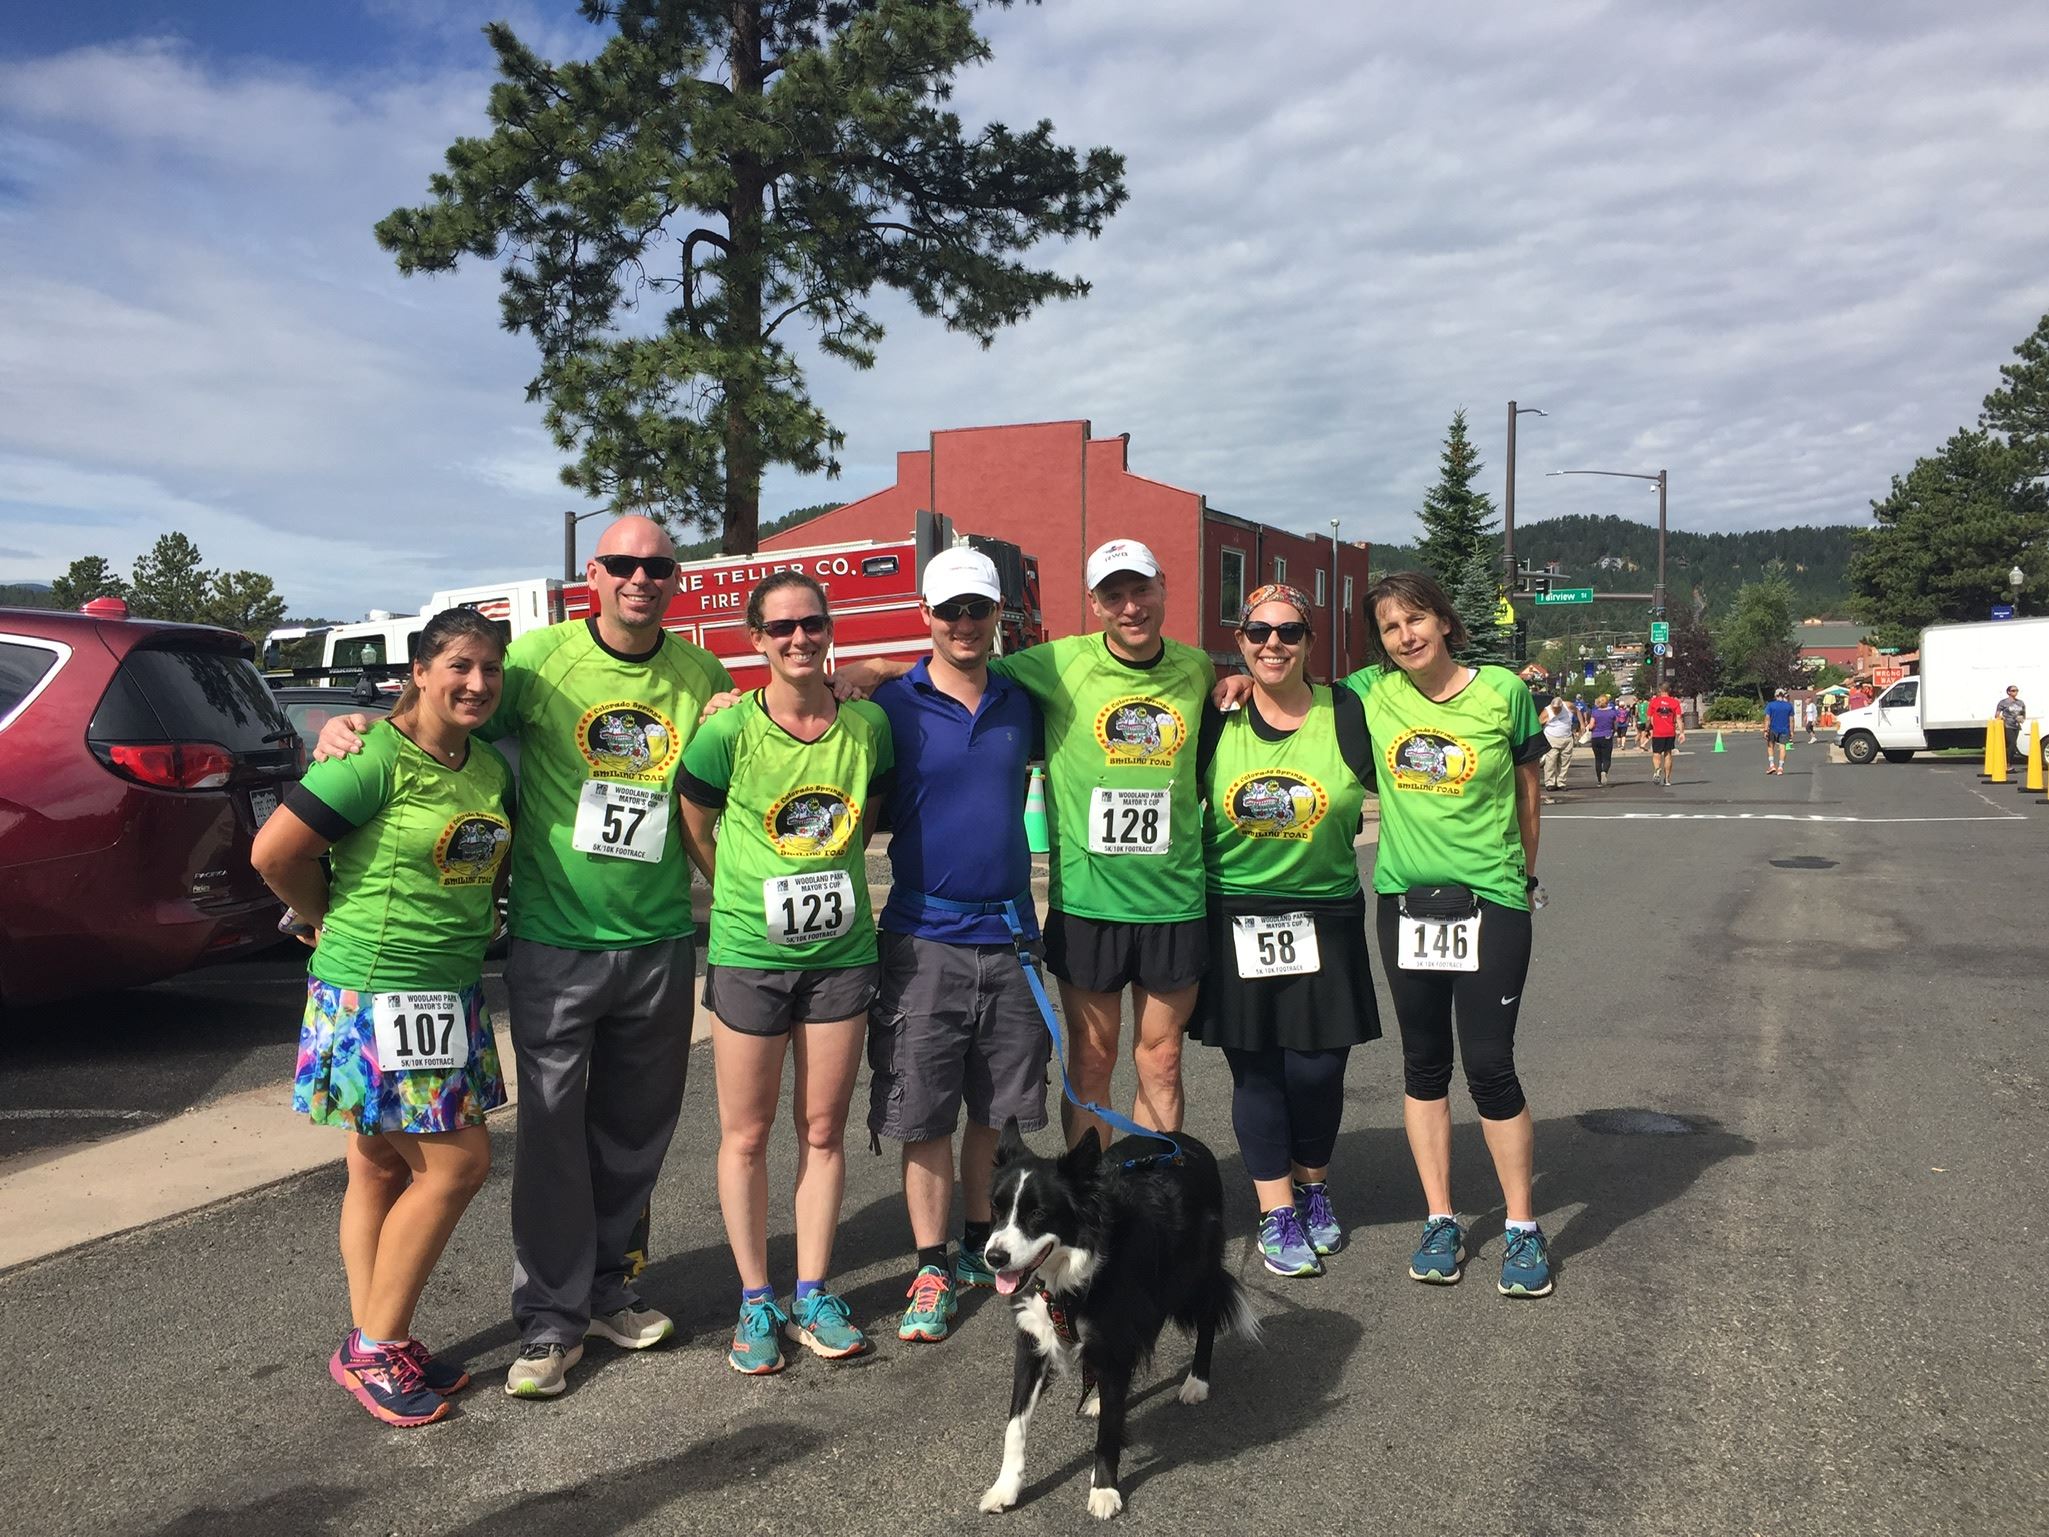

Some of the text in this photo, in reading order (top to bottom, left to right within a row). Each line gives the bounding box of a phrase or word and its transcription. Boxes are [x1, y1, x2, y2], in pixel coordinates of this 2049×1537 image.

[714, 564, 804, 586] TELLER
[815, 557, 857, 576] CO.
[701, 592, 740, 610] FIRE
[594, 701, 662, 720] Colorado Springs
[1150, 758, 1171, 766] TOAD
[593, 770, 665, 781] SMILING TOAD
[615, 786, 649, 799] WOODLAND
[650, 792, 665, 801] PARK
[780, 785, 844, 804] Colorado Springs
[1397, 783, 1460, 795] SMILING TOAD
[619, 795, 658, 808] MAYOR'S CUP
[602, 803, 646, 847] 57
[1102, 808, 1159, 844] 128
[1283, 831, 1308, 839] TOAD
[593, 843, 646, 859] 5K/10K FOOTRACE
[824, 849, 845, 857] TOAD
[795, 872, 844, 886] WOODLAND PARK
[801, 881, 841, 892] MAYOR'S CUP
[782, 891, 843, 936] 123
[1260, 914, 1291, 924] WOODLAND
[1266, 921, 1291, 929] MAYOR'S
[785, 930, 837, 944] 5K/10K FOOTRACE
[1414, 924, 1468, 960] 146
[1257, 930, 1296, 966] 58
[407, 994, 458, 1003] WOODLAND PARK
[414, 1002, 441, 1010] MAYOR'S
[442, 1002, 454, 1010] CUP
[393, 1013, 455, 1057] 107
[401, 1057, 454, 1067] 5K/10K FOOTRACE
